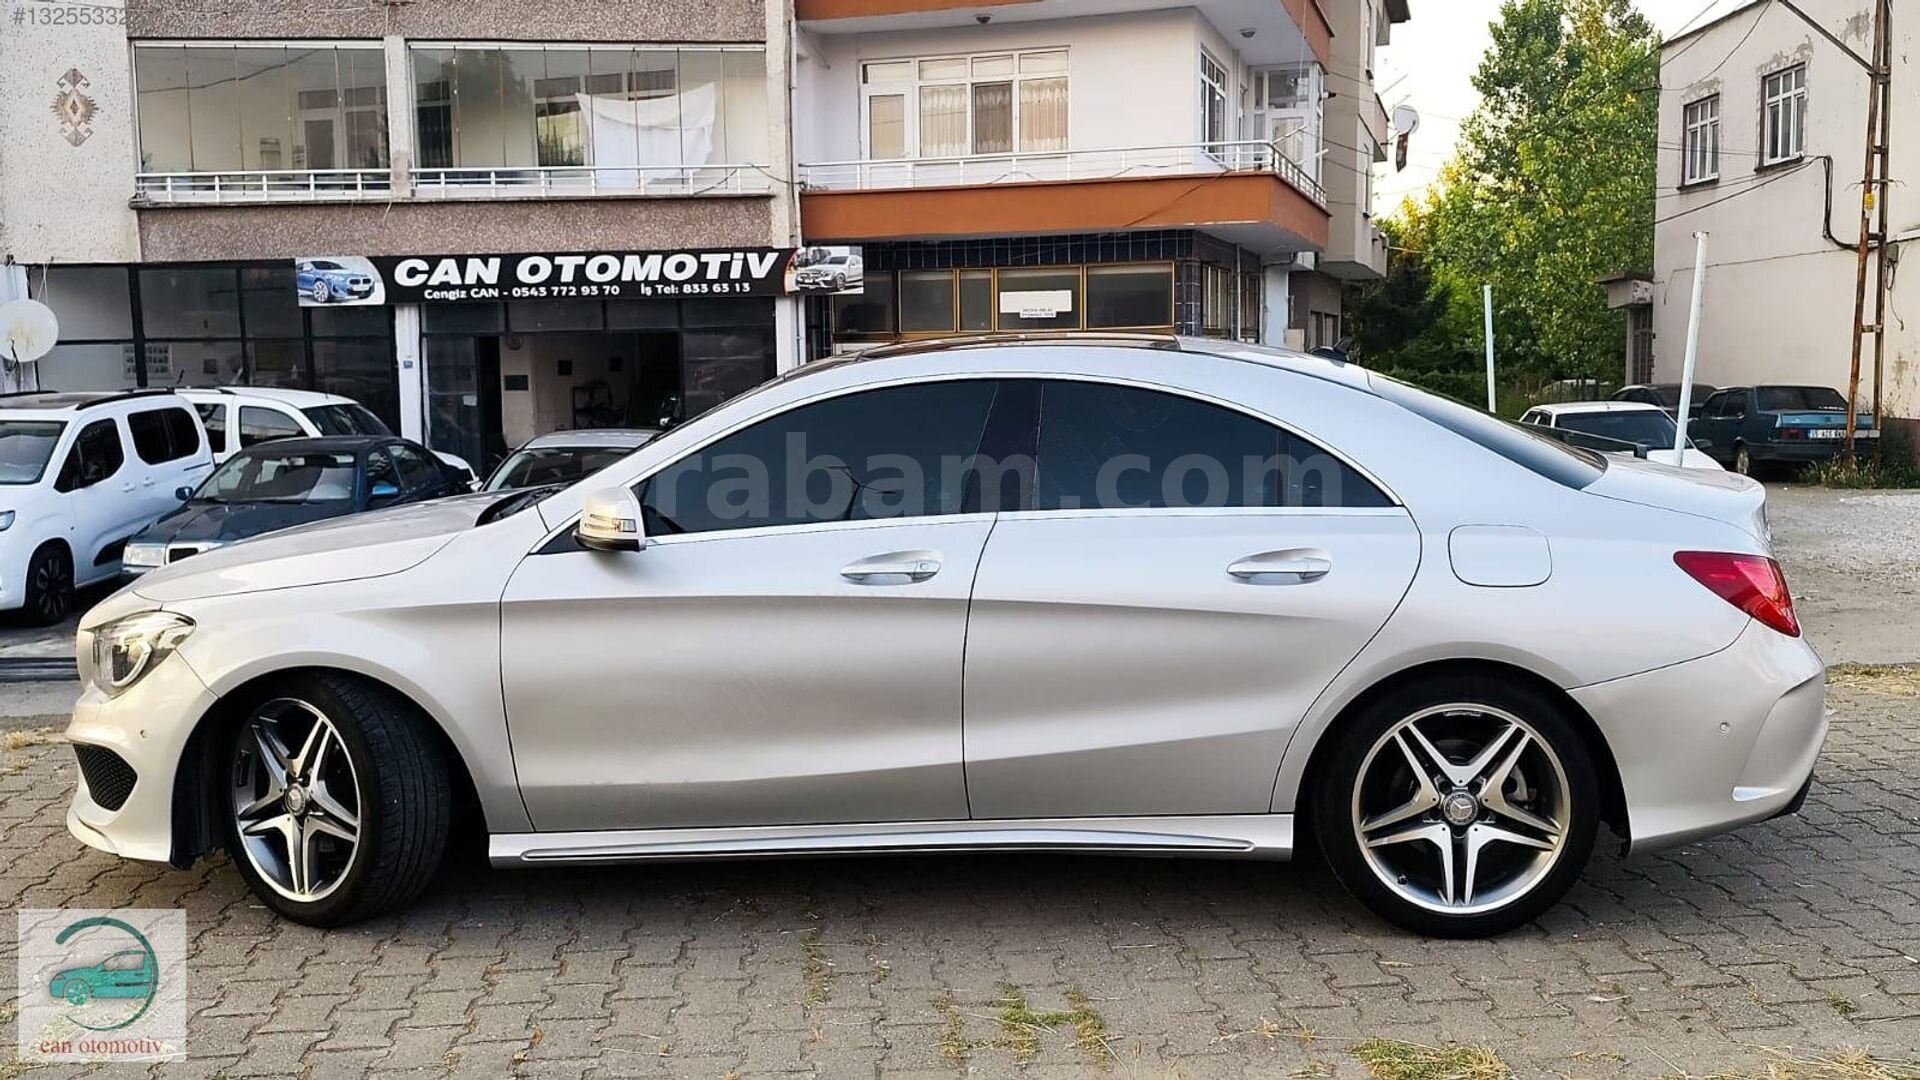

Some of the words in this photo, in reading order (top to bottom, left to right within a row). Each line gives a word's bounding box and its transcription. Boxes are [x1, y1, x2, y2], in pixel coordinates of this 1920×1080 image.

[394, 257, 501, 287] CAN
[470, 288, 499, 298] CAN
[511, 286, 547, 297] 0543
[551, 286, 577, 296] 772
[581, 286, 598, 296] 93
[602, 285, 620, 295] 70
[655, 284, 679, 294] Tel:
[682, 283, 708, 294] 833
[712, 283, 730, 293] 63
[735, 282, 751, 292] 13
